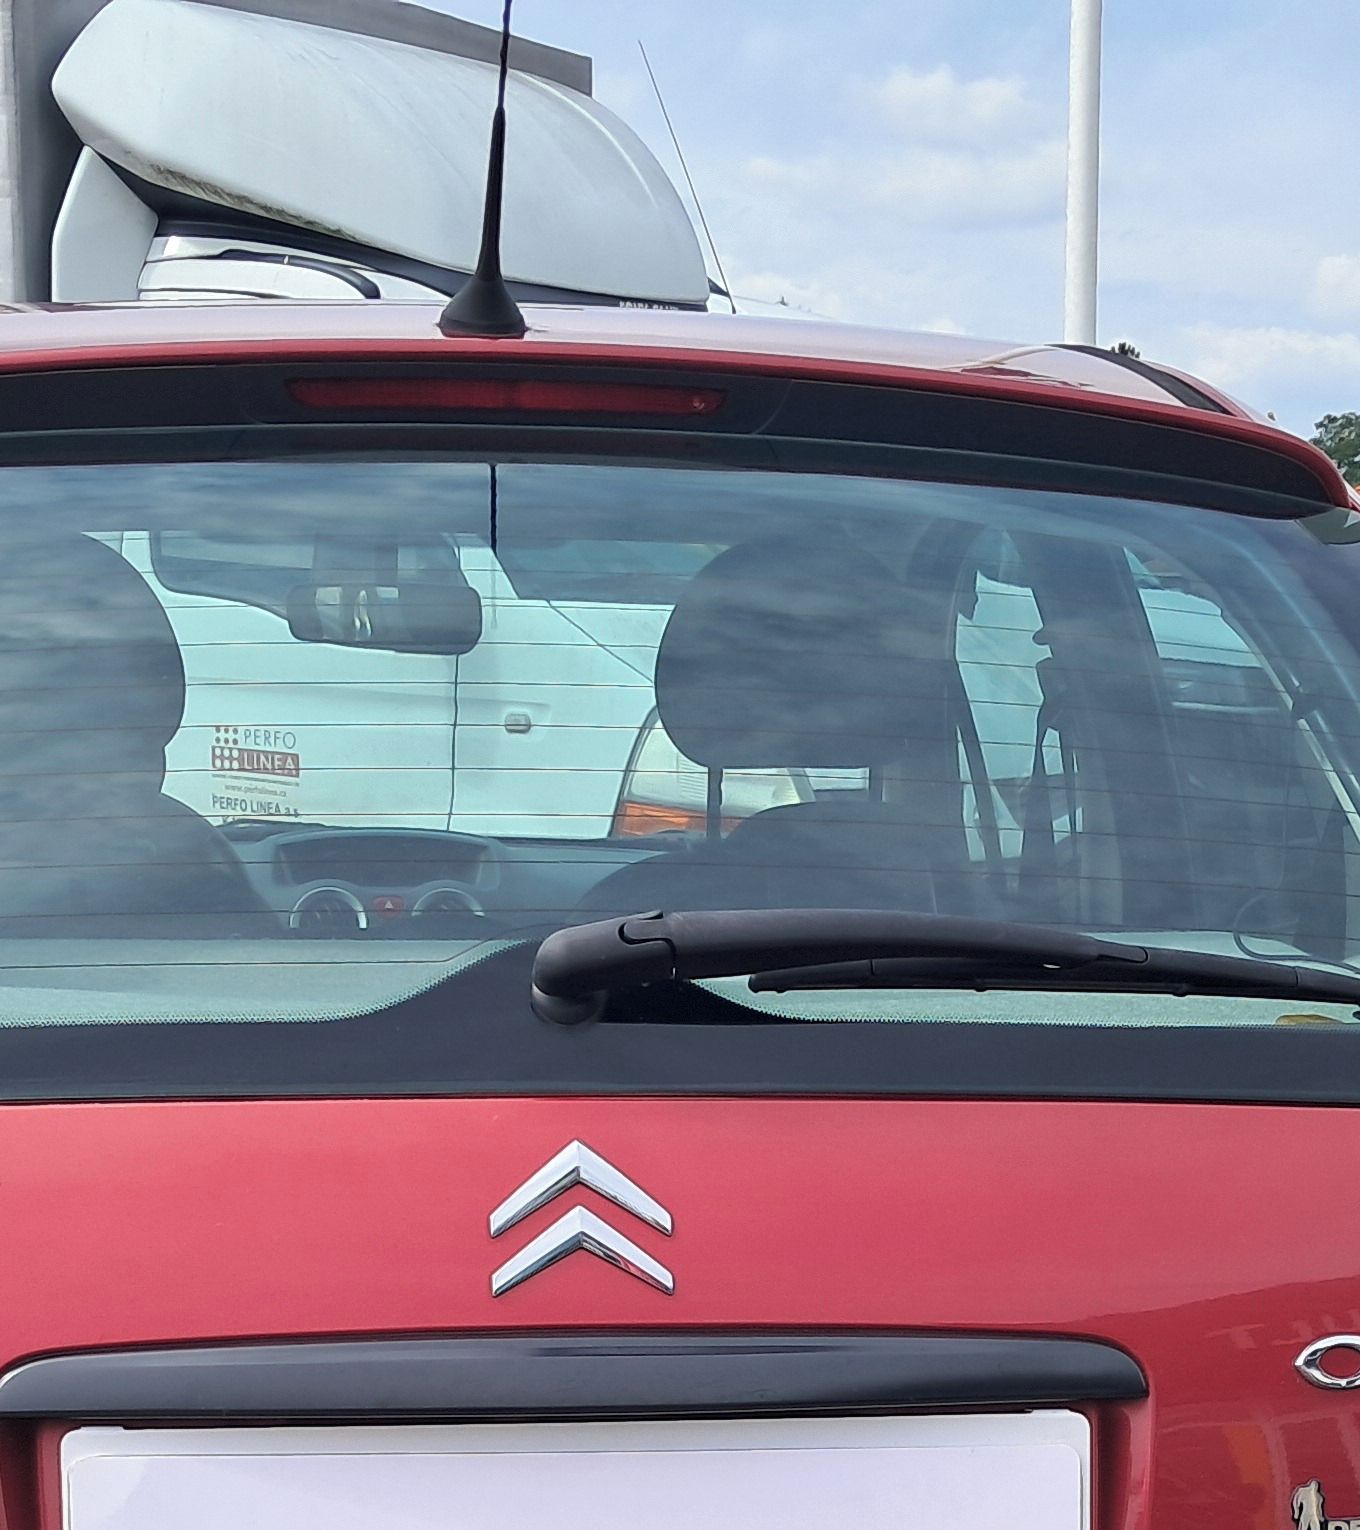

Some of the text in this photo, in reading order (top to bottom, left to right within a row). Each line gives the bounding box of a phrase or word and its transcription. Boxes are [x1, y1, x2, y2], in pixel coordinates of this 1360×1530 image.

[244, 728, 297, 750] PERFO
[243, 751, 297, 775] LINEA
[211, 792, 248, 813] PERFO
[250, 799, 281, 815] LINEA
